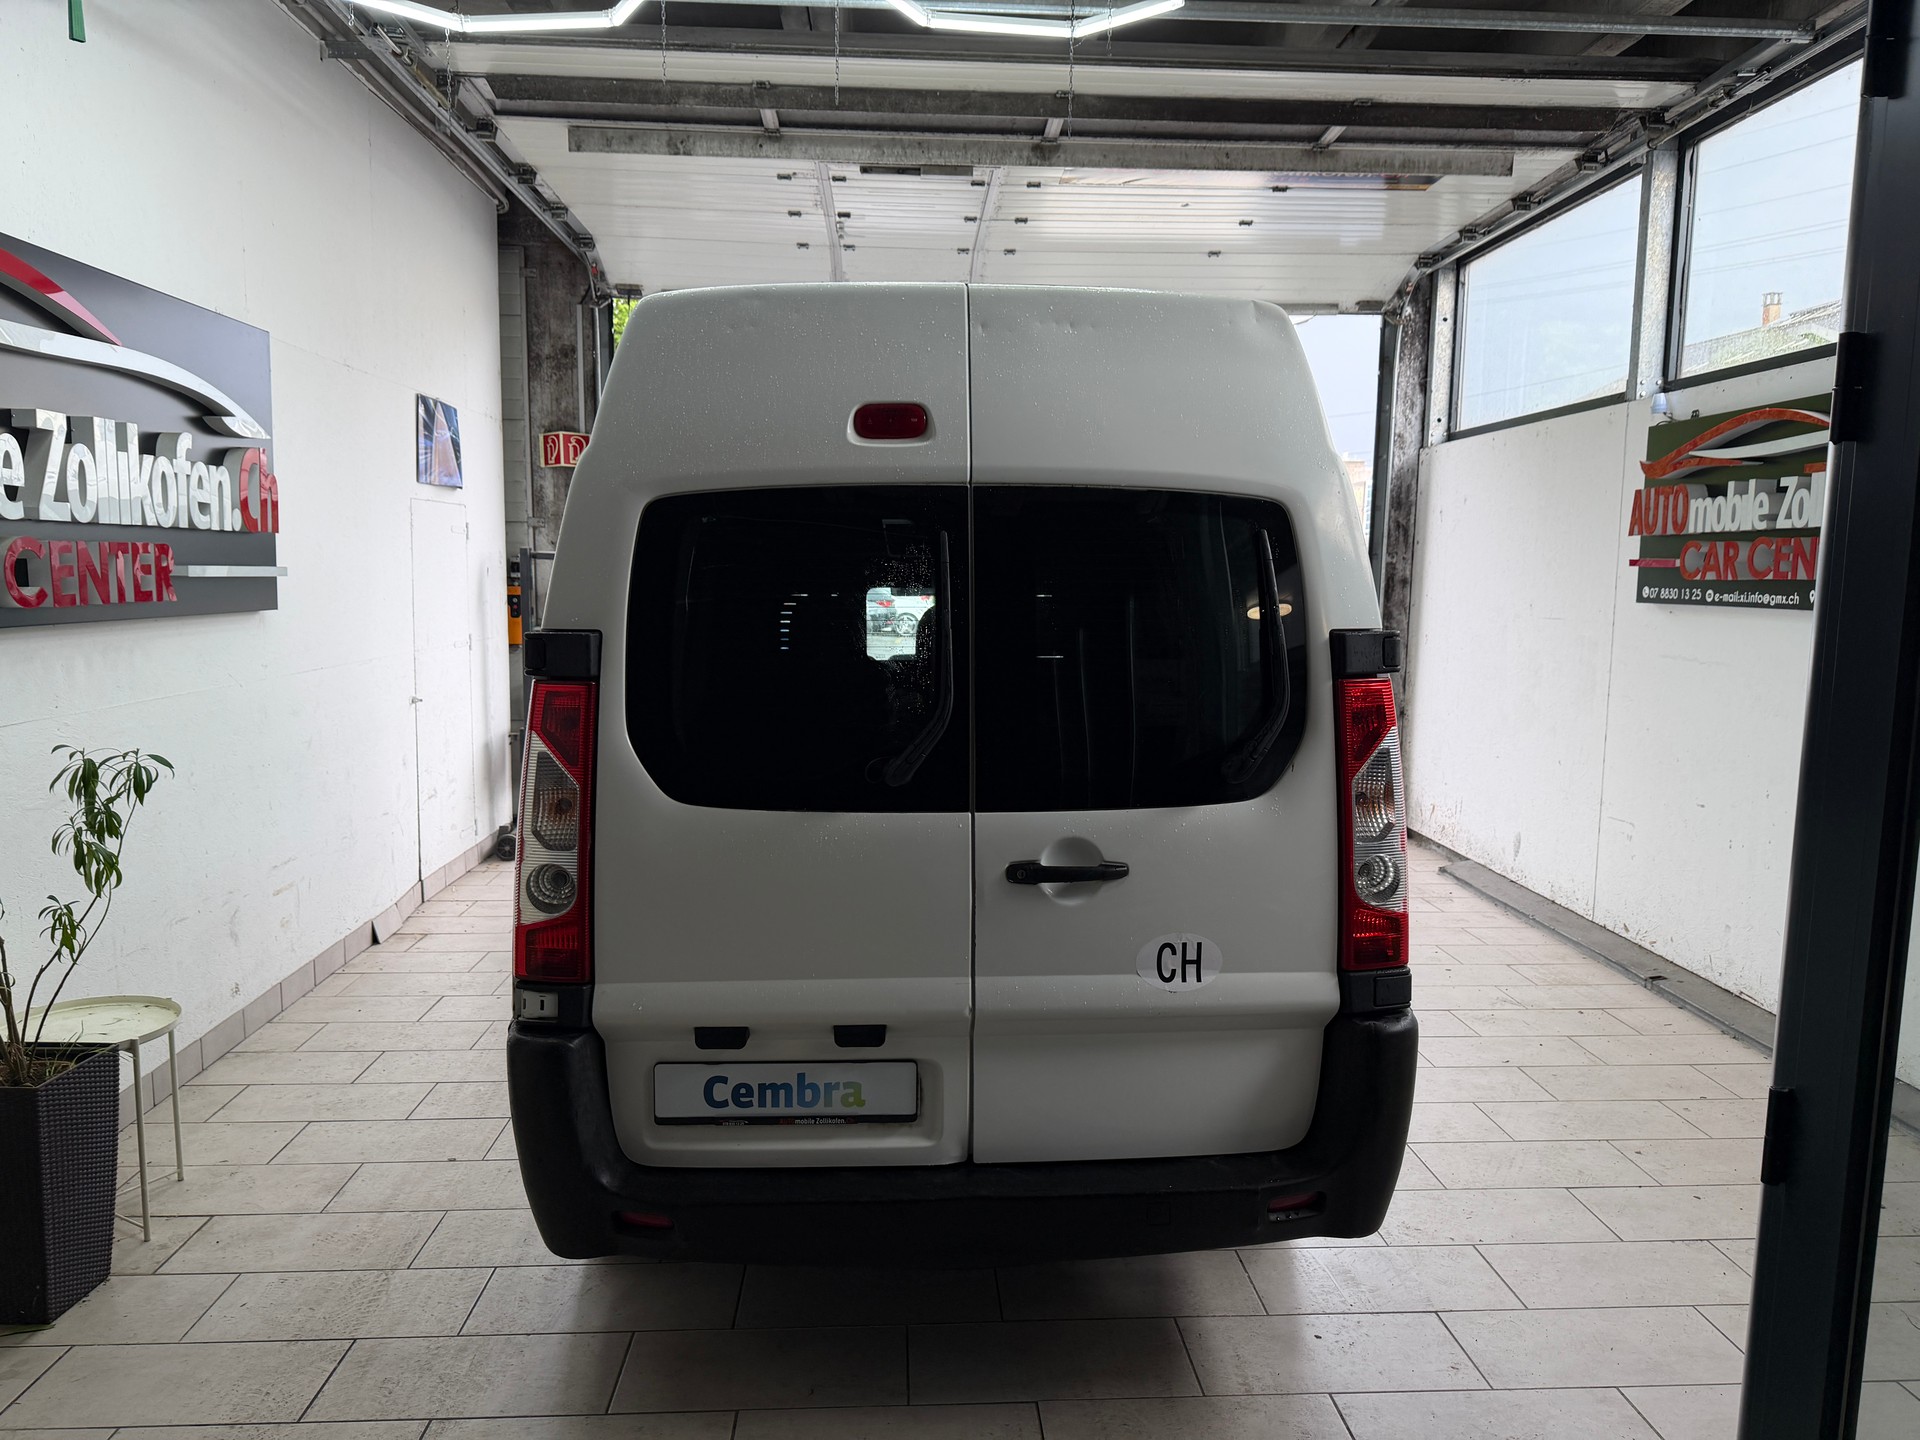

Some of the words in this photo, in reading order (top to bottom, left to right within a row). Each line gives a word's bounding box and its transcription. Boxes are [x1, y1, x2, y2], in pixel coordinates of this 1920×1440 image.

[1628, 478, 1769, 536] AUTOmobile
[4, 537, 177, 608] CENTER
[1679, 540, 1739, 580] CAR
[1649, 588, 1659, 599] 07
[1660, 588, 1678, 599] 8830
[1681, 589, 1690, 600] 13
[1691, 589, 1702, 600] 25
[1156, 942, 1203, 983] CH
[703, 1072, 866, 1109] Cembra
